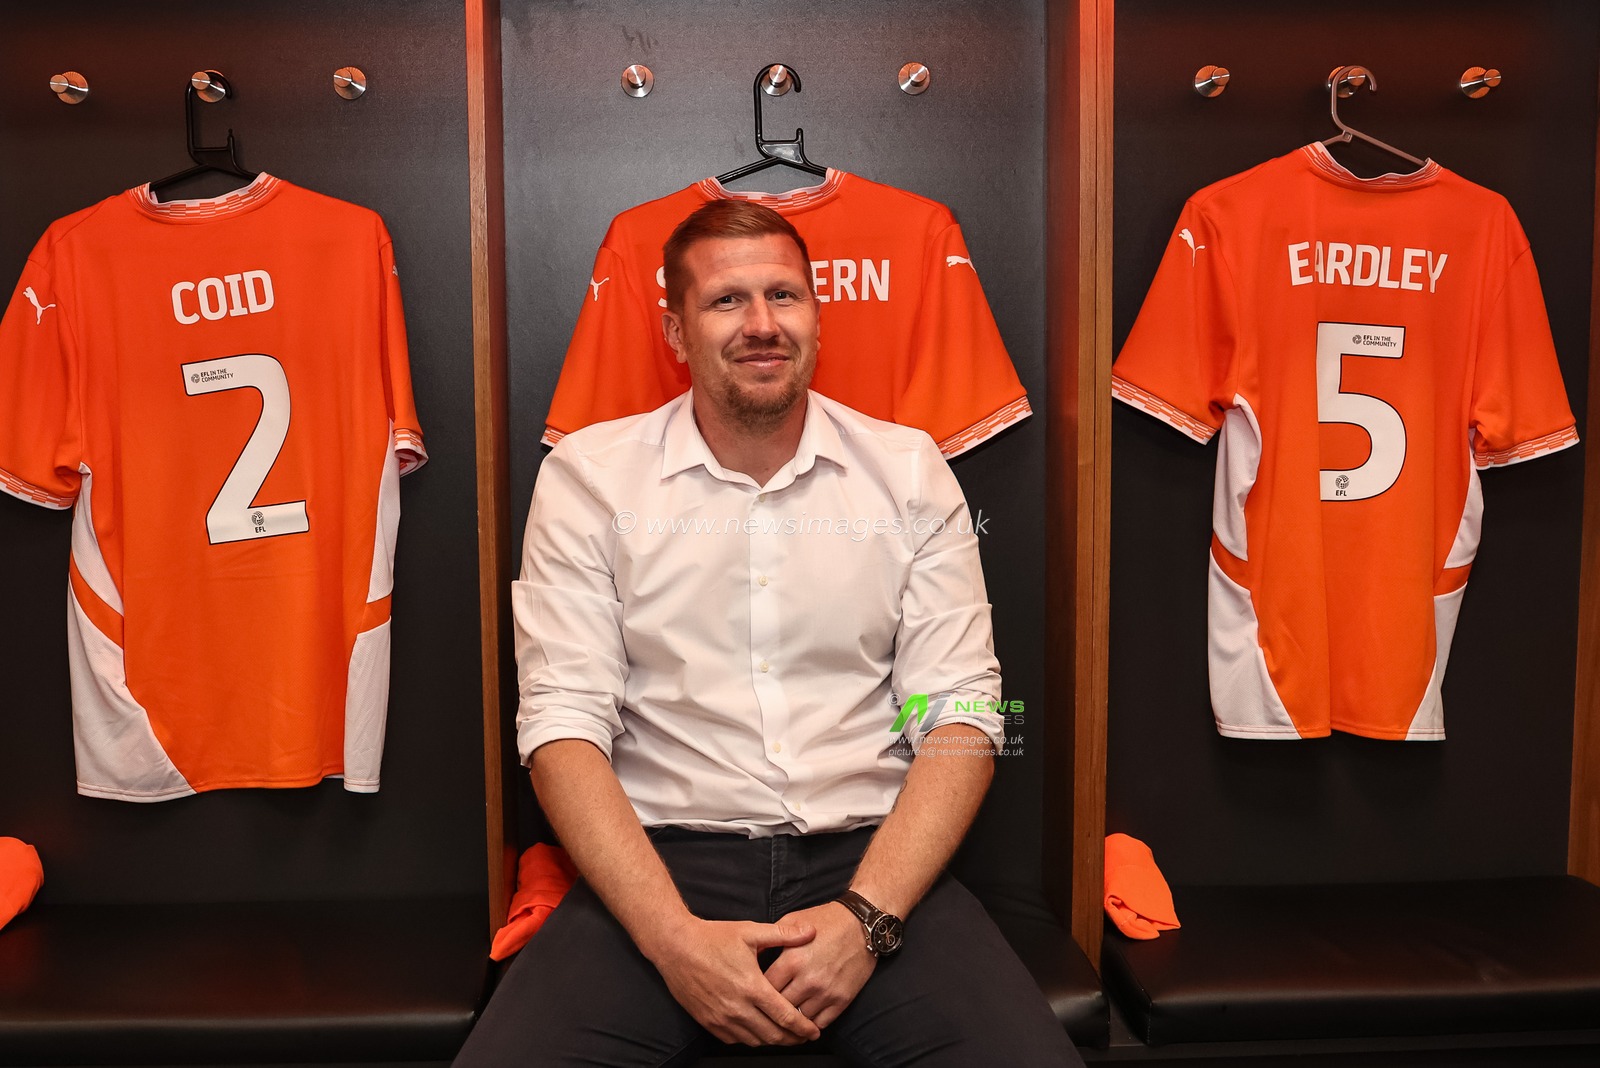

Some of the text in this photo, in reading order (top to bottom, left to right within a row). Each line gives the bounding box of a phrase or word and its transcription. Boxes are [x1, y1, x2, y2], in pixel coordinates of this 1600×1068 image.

[1287, 240, 1449, 294] EARDLEY
[171, 269, 275, 325] COID
[201, 373, 234, 383] COMMUNITY
[1316, 321, 1407, 502] 5
[180, 353, 310, 545] 2
[1335, 489, 1348, 497] EFL
[254, 525, 267, 534] EFL
